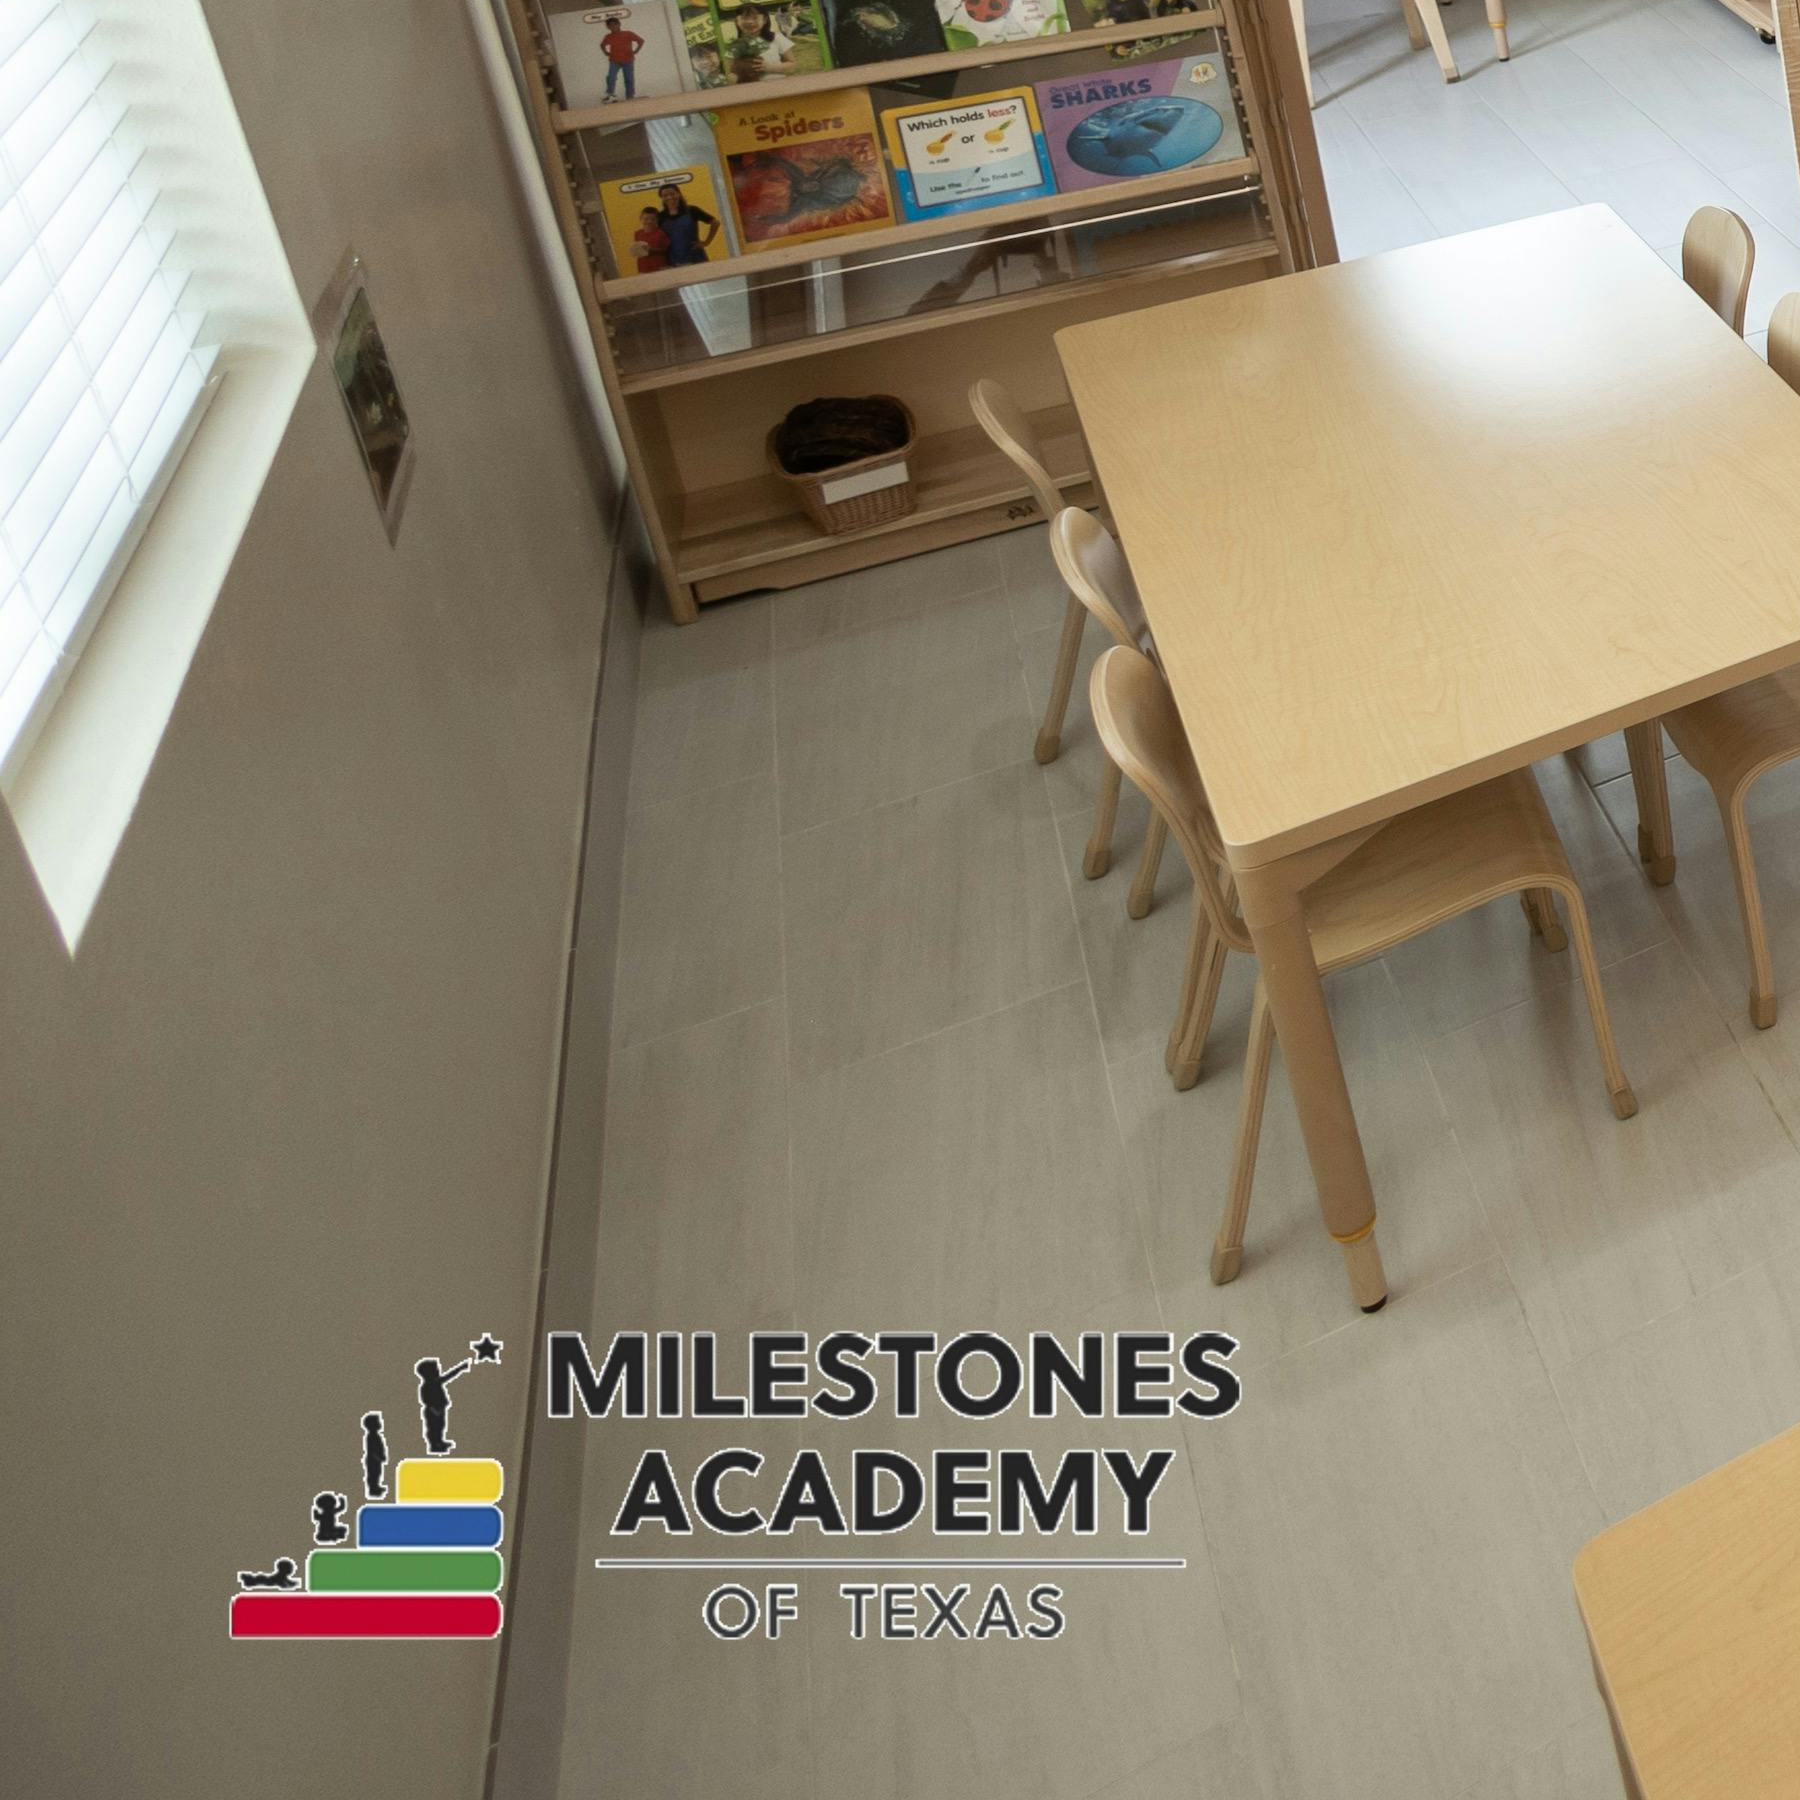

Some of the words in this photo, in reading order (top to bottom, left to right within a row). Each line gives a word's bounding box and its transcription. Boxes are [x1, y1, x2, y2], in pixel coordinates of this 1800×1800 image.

[1051, 78, 1152, 109] SHARKS
[739, 117, 747, 126] A
[751, 113, 779, 125] Look
[784, 110, 796, 120] at
[755, 114, 845, 142] Spiders
[907, 117, 948, 132] Which
[950, 110, 985, 124] holds
[987, 105, 1017, 118] less?
[961, 134, 976, 144] or
[930, 184, 946, 193] Use
[948, 182, 963, 190] the
